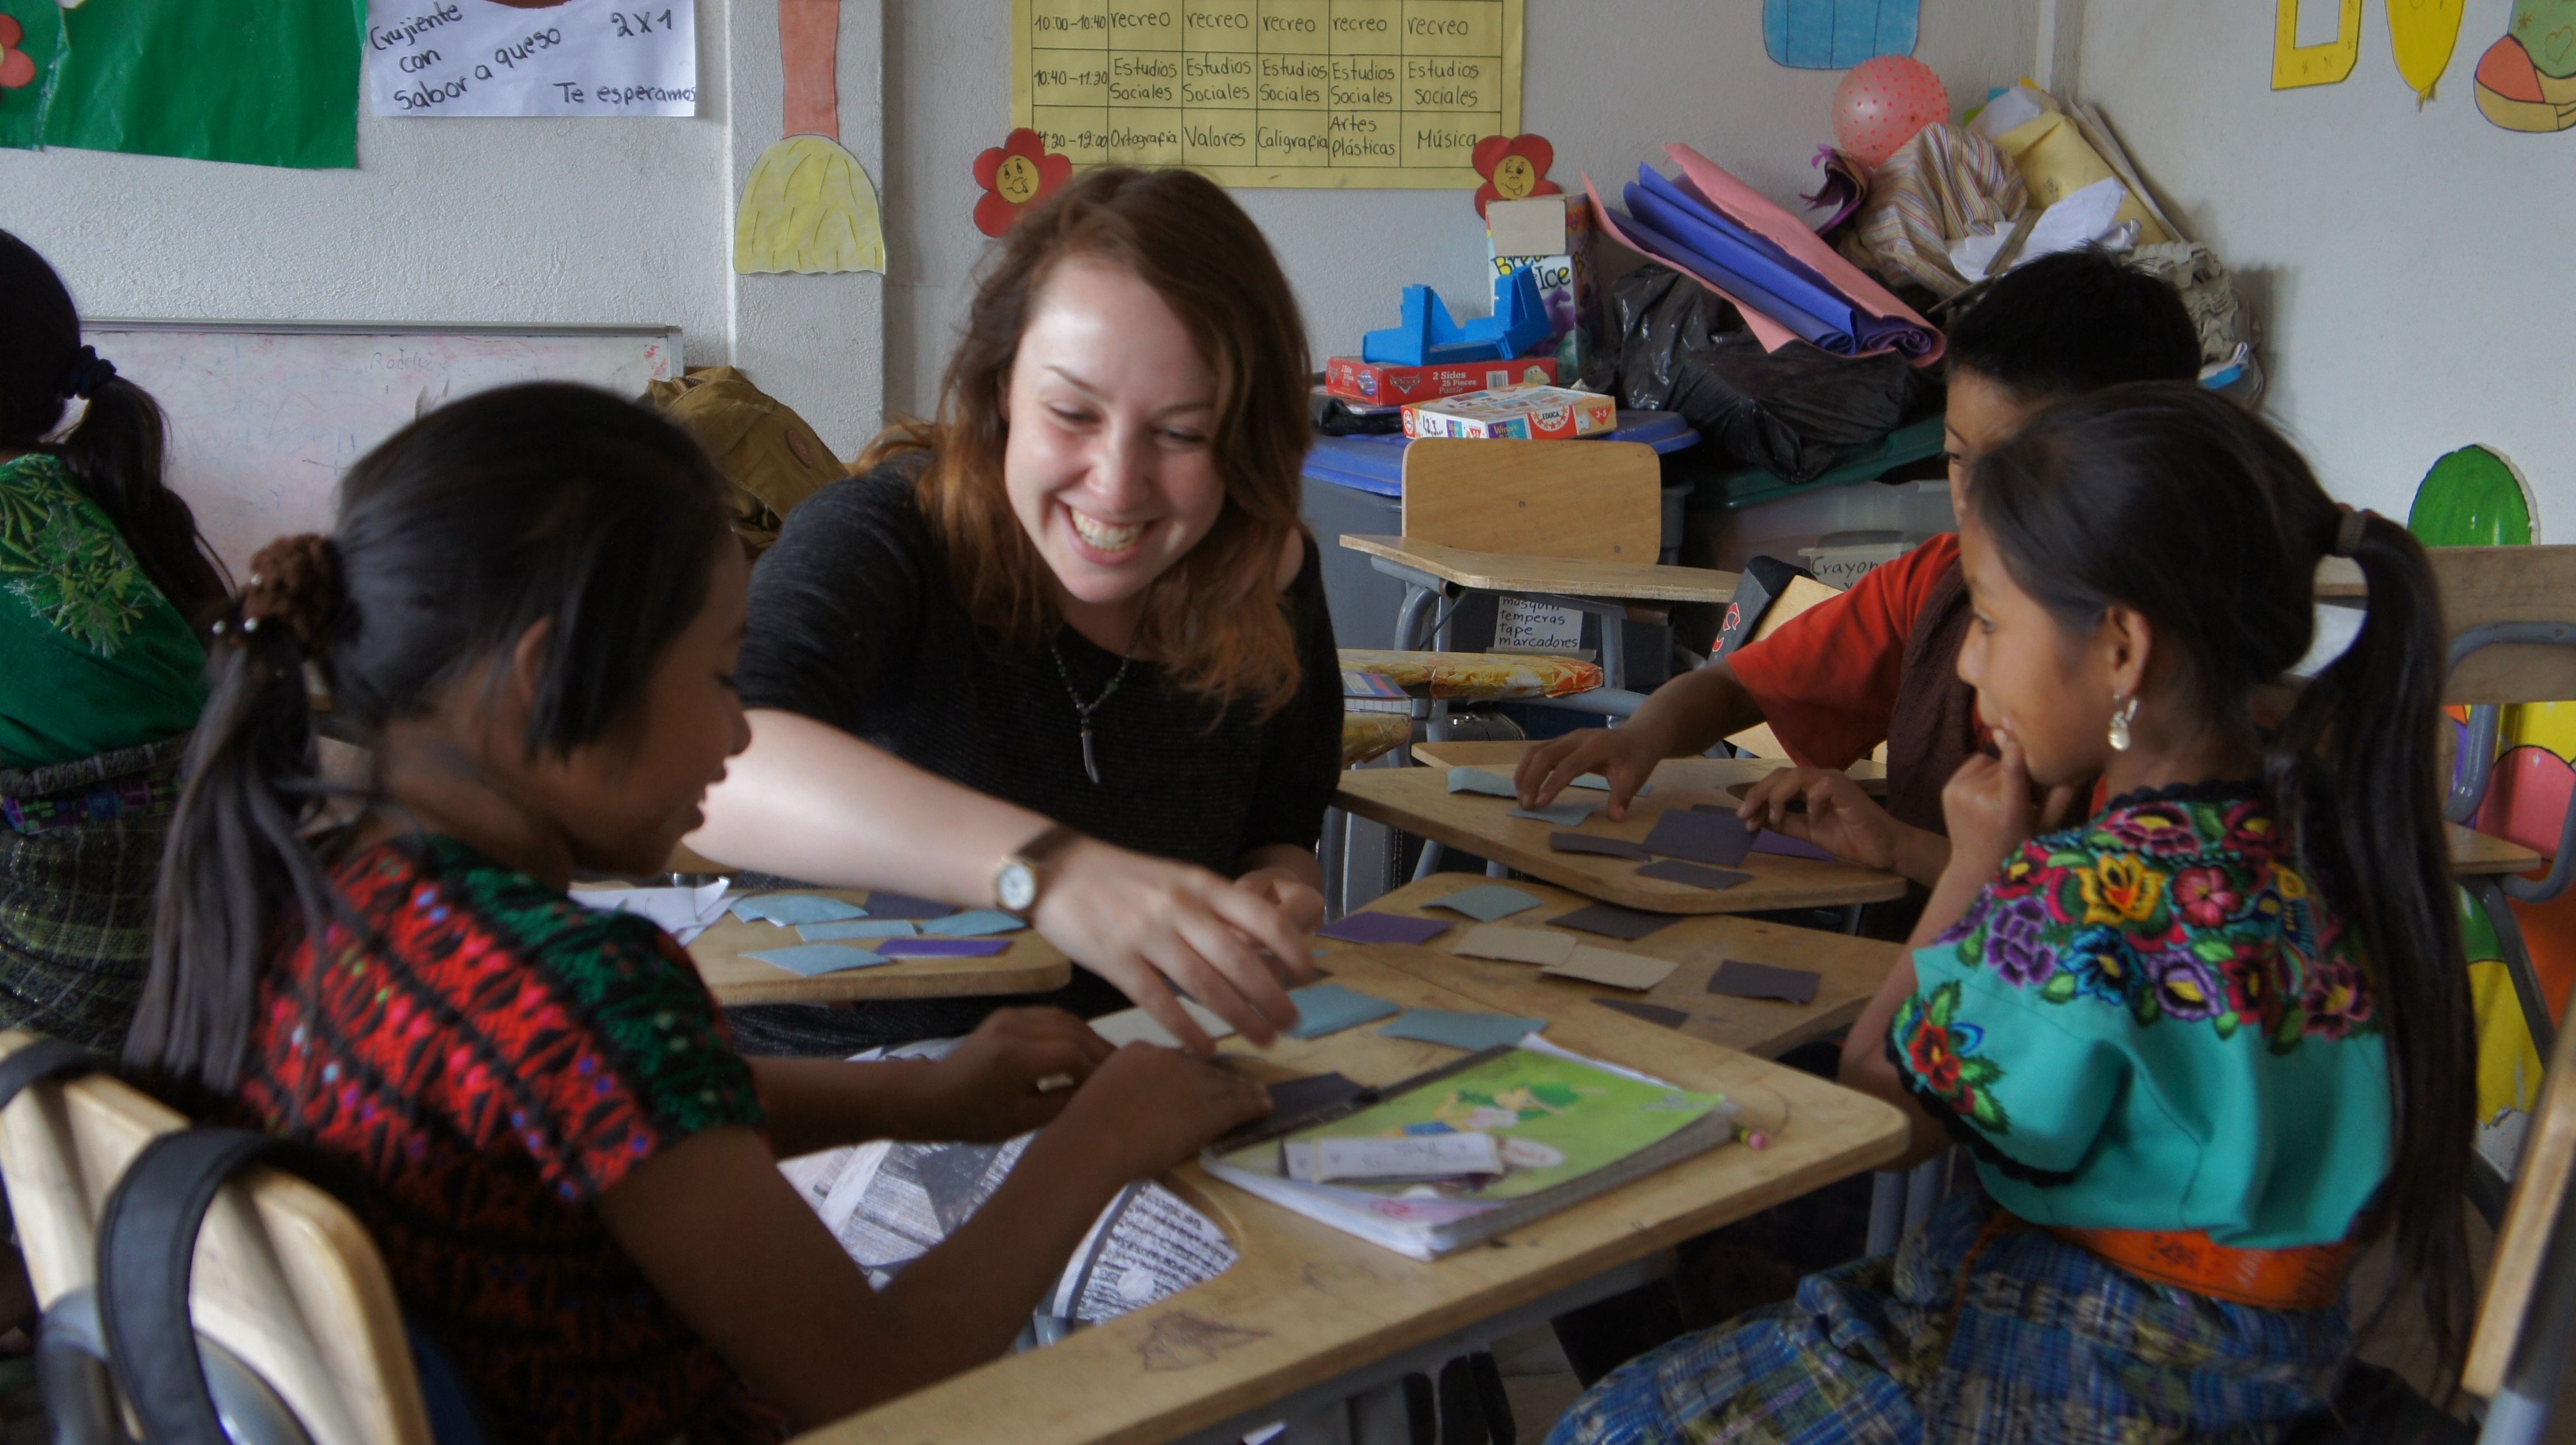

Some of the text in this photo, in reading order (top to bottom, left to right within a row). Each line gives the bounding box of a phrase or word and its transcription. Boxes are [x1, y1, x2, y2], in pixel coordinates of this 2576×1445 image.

[1111, 12, 1170, 28] recreo
[1186, 13, 1248, 29] recreo
[1263, 16, 1315, 32] recreo
[1333, 17, 1387, 31] recreo
[1408, 17, 1468, 35] recreo
[400, 48, 441, 73] con
[475, 64, 493, 80] a
[495, 27, 561, 68] queso
[1114, 57, 1177, 77] Estudios
[1186, 53, 1251, 76] Estudios
[1263, 56, 1327, 79] Estudios
[1332, 58, 1395, 80] Estudios
[1409, 59, 1479, 79] Estudios
[553, 82, 696, 105] Te esperamos
[1110, 82, 1172, 100] Sociales
[1182, 84, 1249, 102] Sociales
[1260, 84, 1319, 102] Sociales
[1331, 85, 1392, 104] Sociales
[1330, 114, 1377, 132] Artes
[1184, 125, 1245, 147] Valores
[1417, 128, 1478, 149] Música
[1535, 265, 1571, 290] Ice
[1433, 371, 1466, 380] 2 Sides
[1542, 411, 1560, 420] EDUCA
[1500, 610, 1565, 627] temperas
[1499, 634, 1578, 648] marcadores
